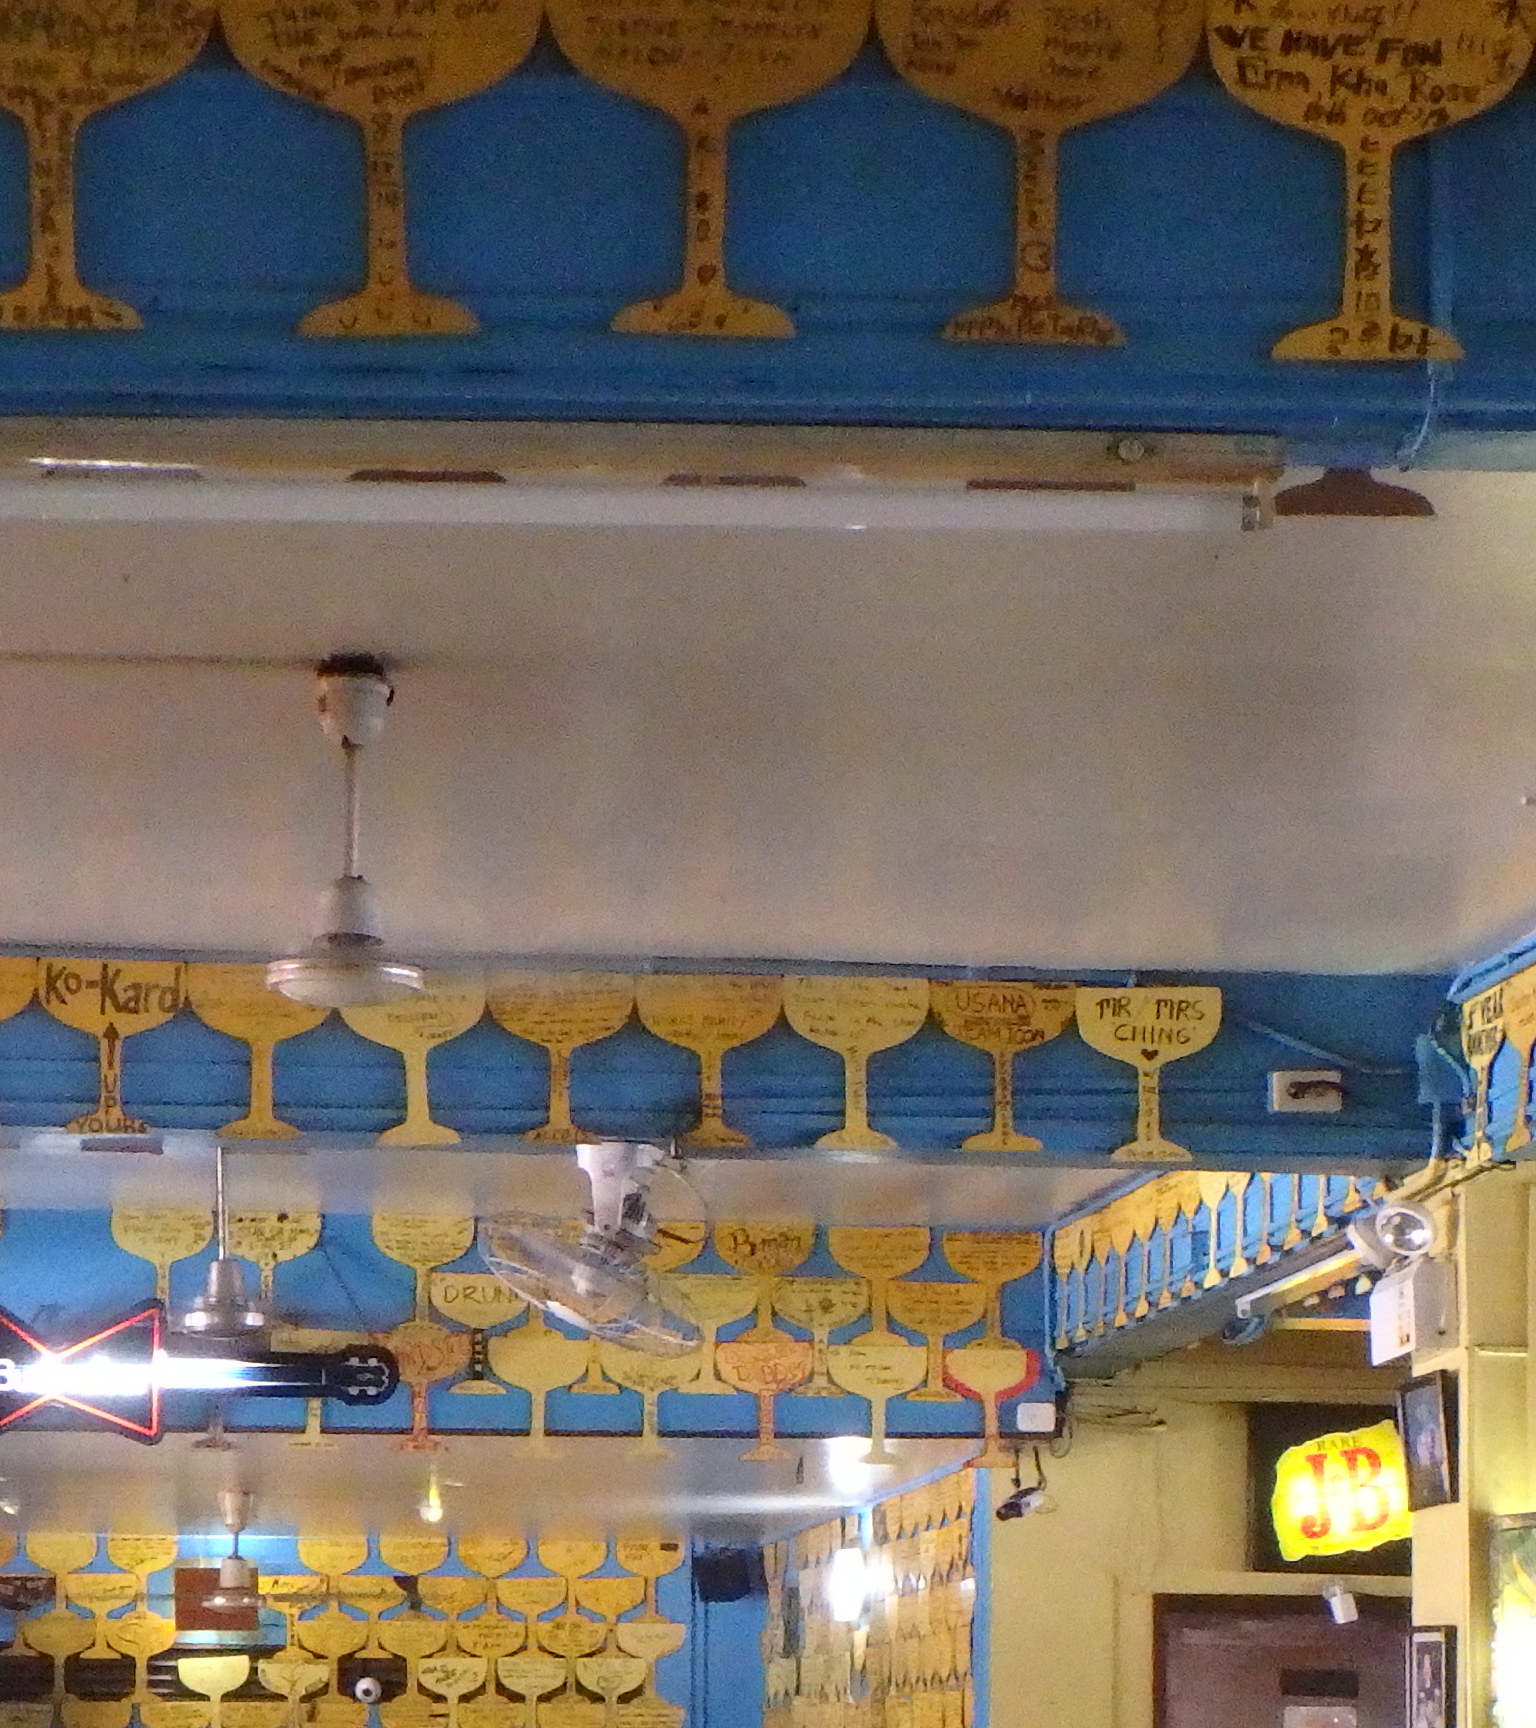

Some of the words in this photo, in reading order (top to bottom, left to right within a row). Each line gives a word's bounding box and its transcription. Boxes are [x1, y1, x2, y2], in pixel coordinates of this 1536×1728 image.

[44, 961, 182, 1016] Ko-Kard
[1095, 997, 1132, 1019] MR
[1155, 998, 1206, 1021] MRS
[1300, 1445, 1391, 1540] JB
